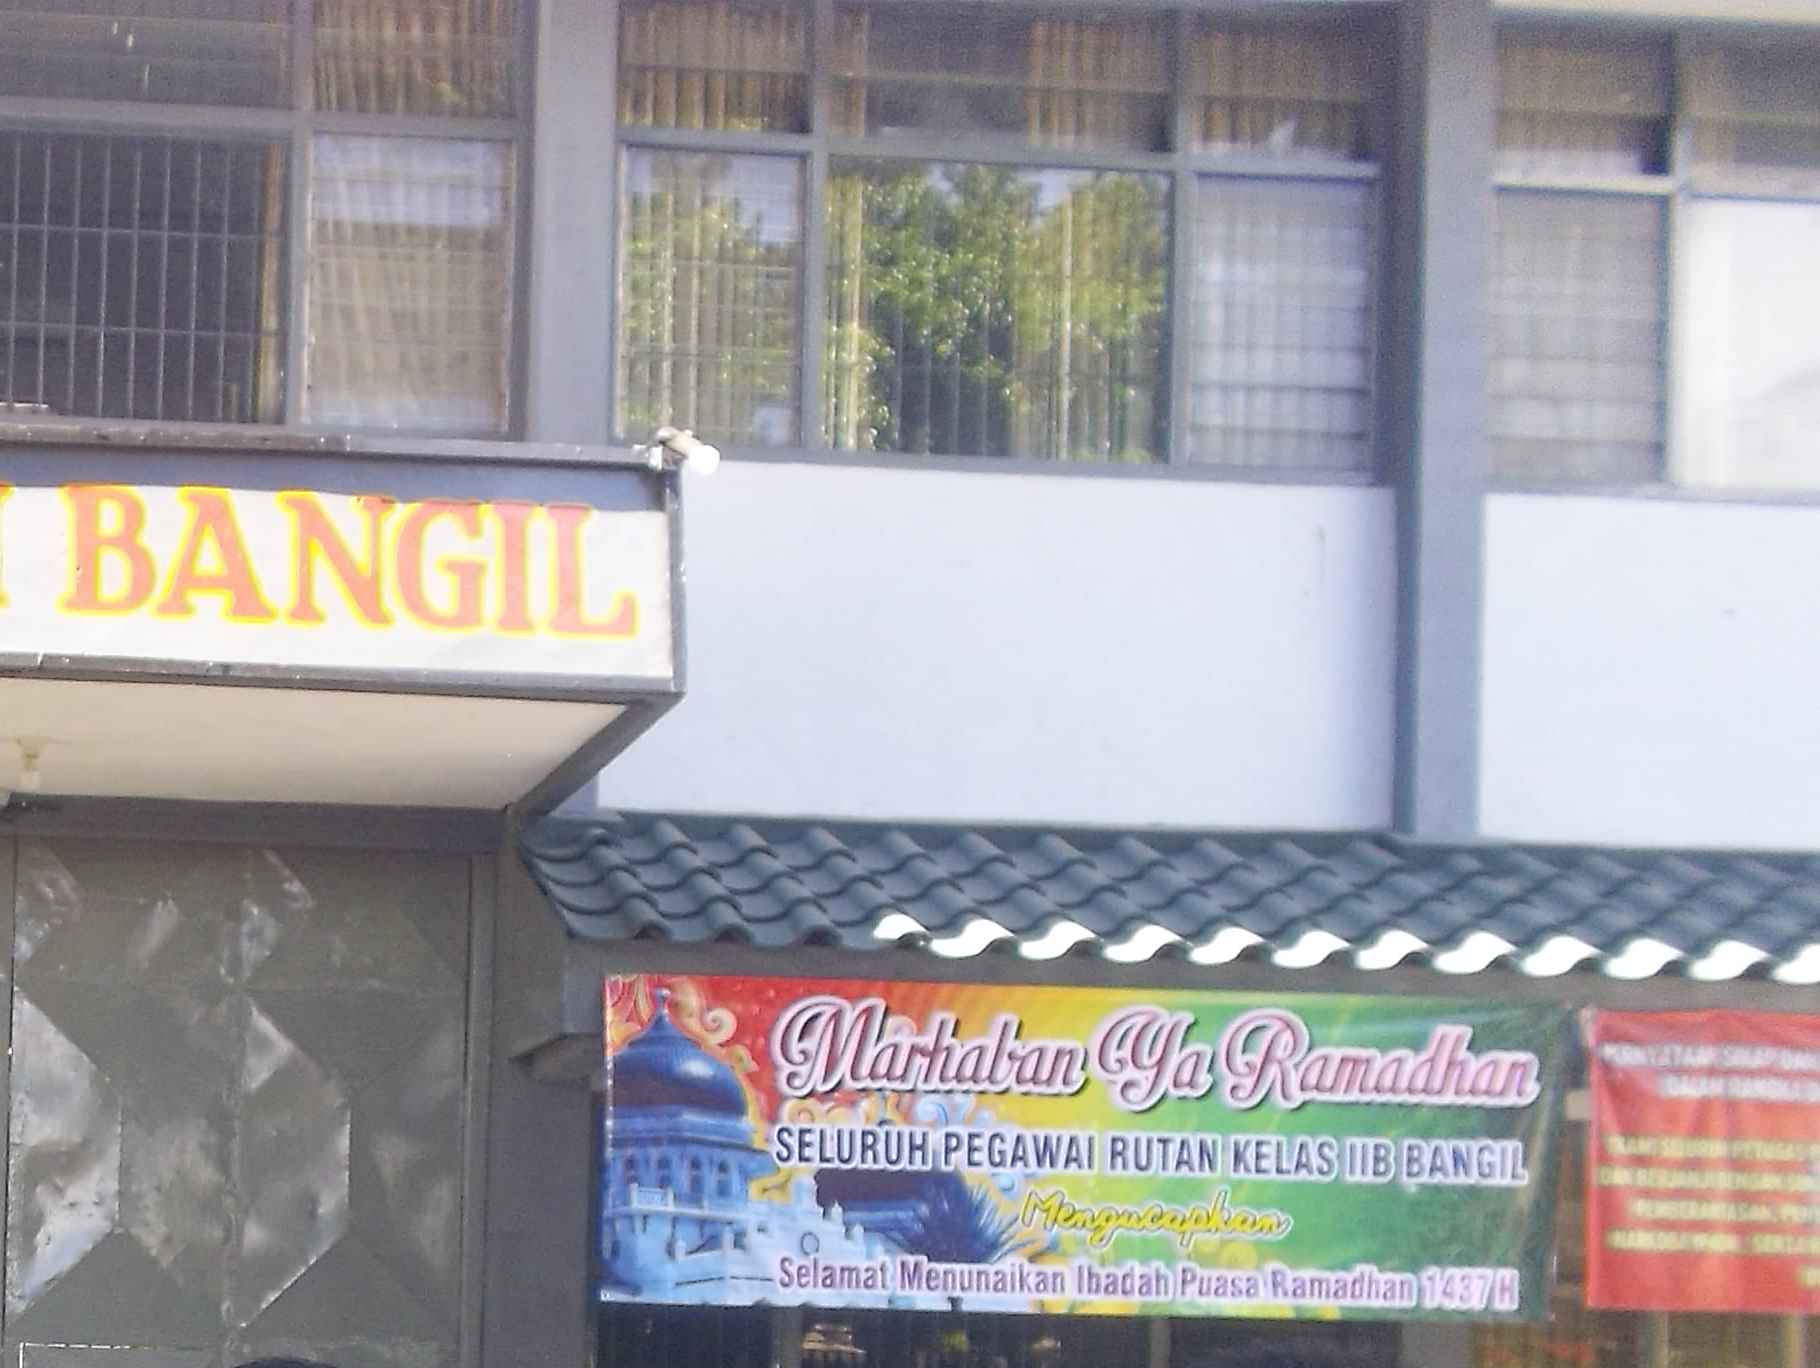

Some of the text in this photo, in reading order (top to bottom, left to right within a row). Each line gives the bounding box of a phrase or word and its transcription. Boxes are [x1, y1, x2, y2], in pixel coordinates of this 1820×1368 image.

[57, 482, 639, 641] BANGIL
[771, 995, 1540, 1112] Marhaban Ya Ramadhan
[775, 1126, 1527, 1183] SELURUH PEGAWAI RUTAN KELAS IIB BANGIL
[1020, 1188, 1292, 1250] Mengucapkan
[779, 1255, 889, 1292] Selamat
[896, 1257, 1067, 1294] Menunaikan
[1076, 1262, 1171, 1297] Ibadah
[1179, 1266, 1261, 1301] Puasa
[1269, 1266, 1416, 1304] Ramadhan
